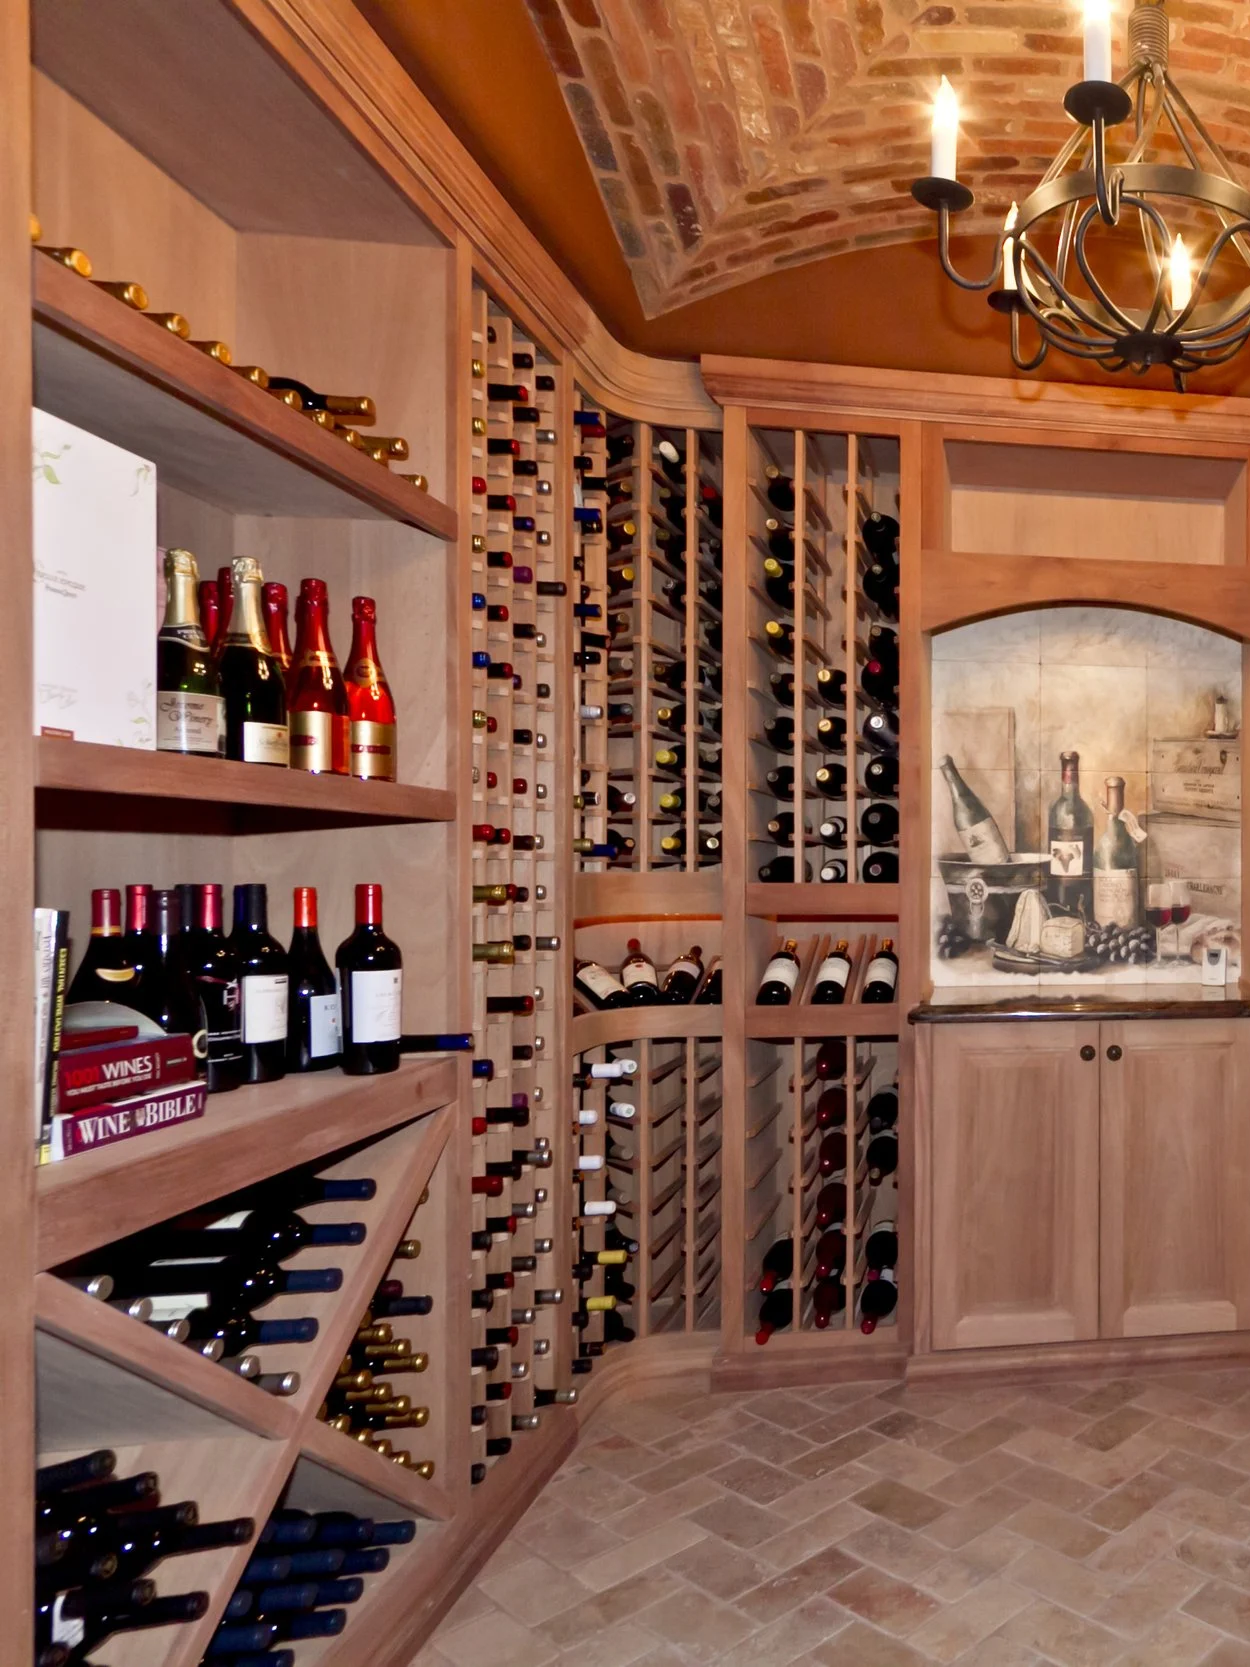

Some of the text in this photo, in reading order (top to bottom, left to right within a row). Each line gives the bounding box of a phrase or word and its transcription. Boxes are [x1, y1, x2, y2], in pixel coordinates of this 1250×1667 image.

[64, 1067, 98, 1088] 1001
[102, 1055, 152, 1080] WINES
[77, 1110, 130, 1145] WINE
[145, 1094, 196, 1127] BIBLE
